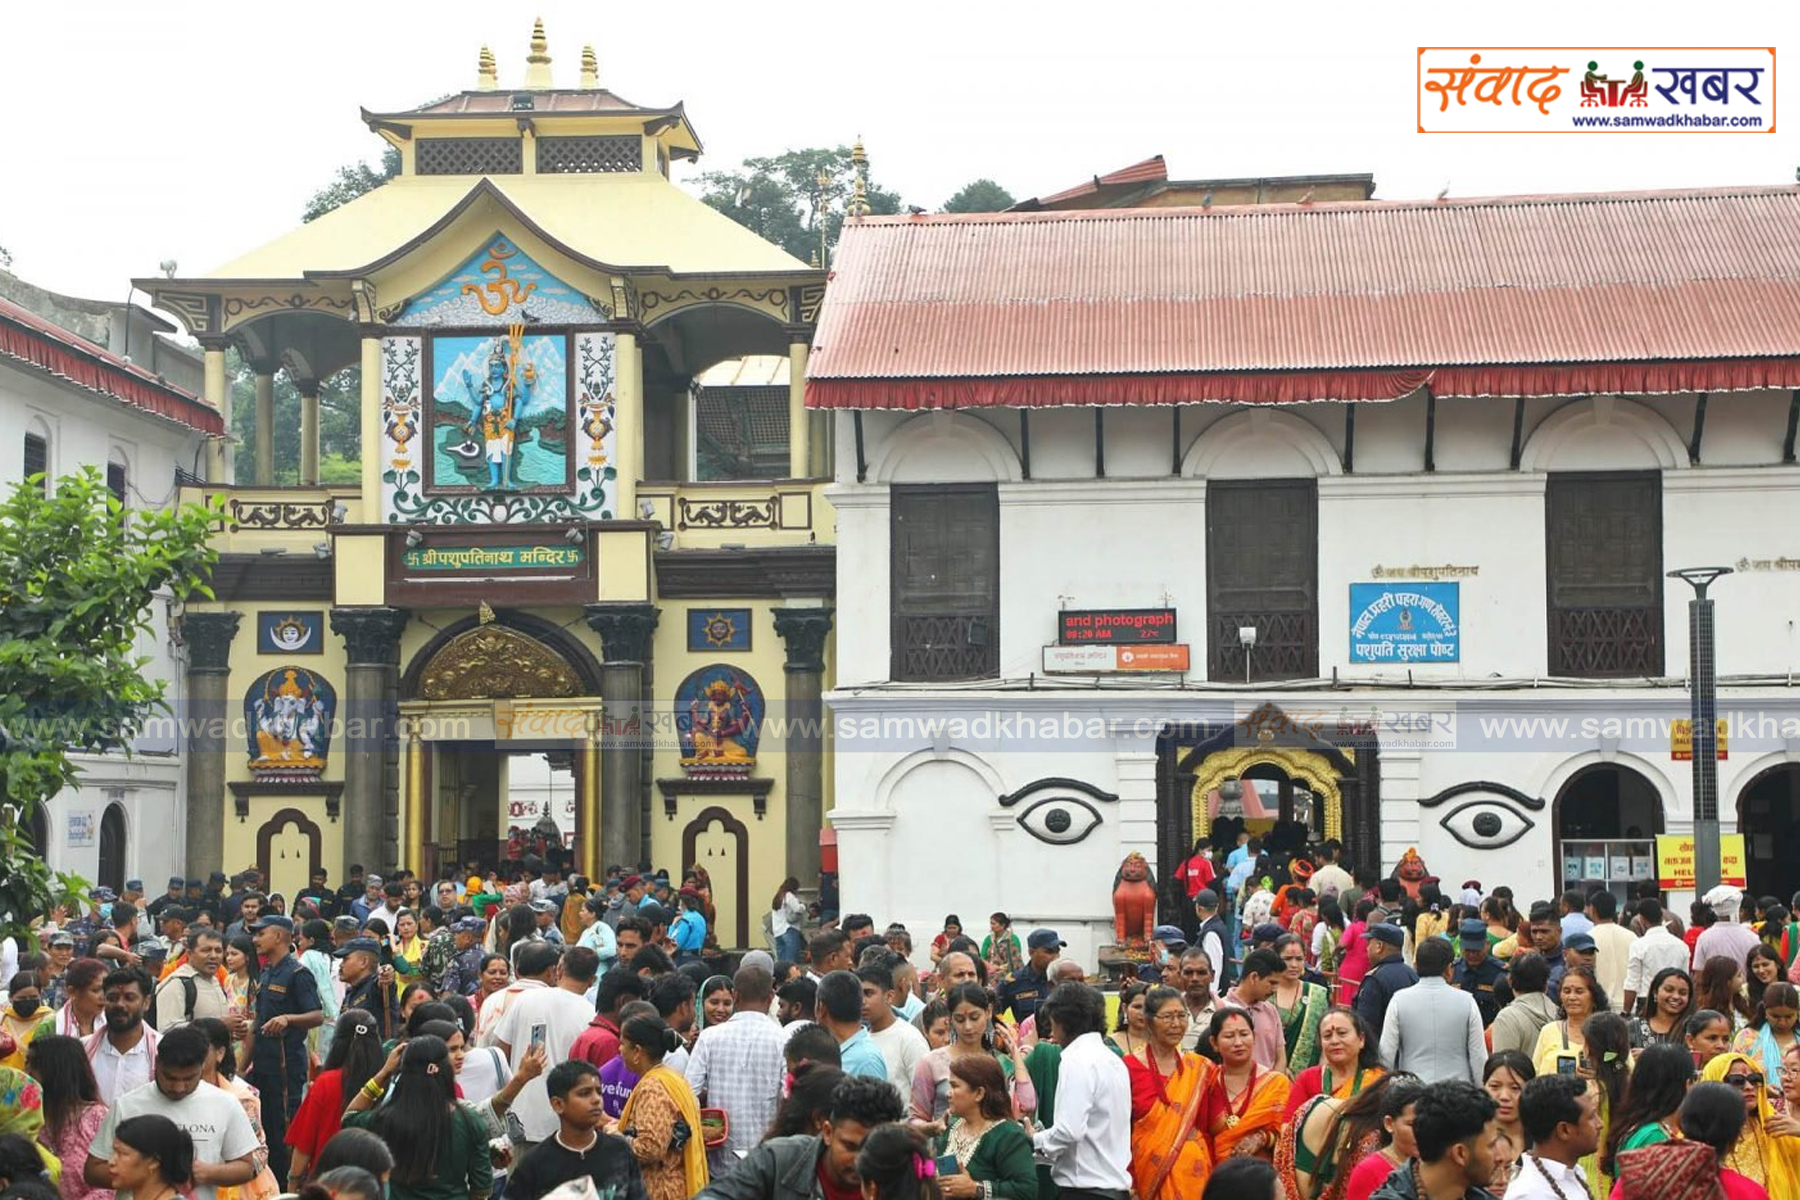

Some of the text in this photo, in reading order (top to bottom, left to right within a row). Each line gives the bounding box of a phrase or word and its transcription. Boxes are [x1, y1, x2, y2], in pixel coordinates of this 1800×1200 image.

[520, 546, 566, 564] मन्दिर
[1066, 612, 1173, 629] and photograph
[1351, 610, 1374, 638] नेपाल
[1368, 592, 1395, 617] प्रहरी
[1096, 629, 1112, 638] AM
[1356, 641, 1395, 660] पशुपति
[1398, 644, 1427, 660] सुरक्षा
